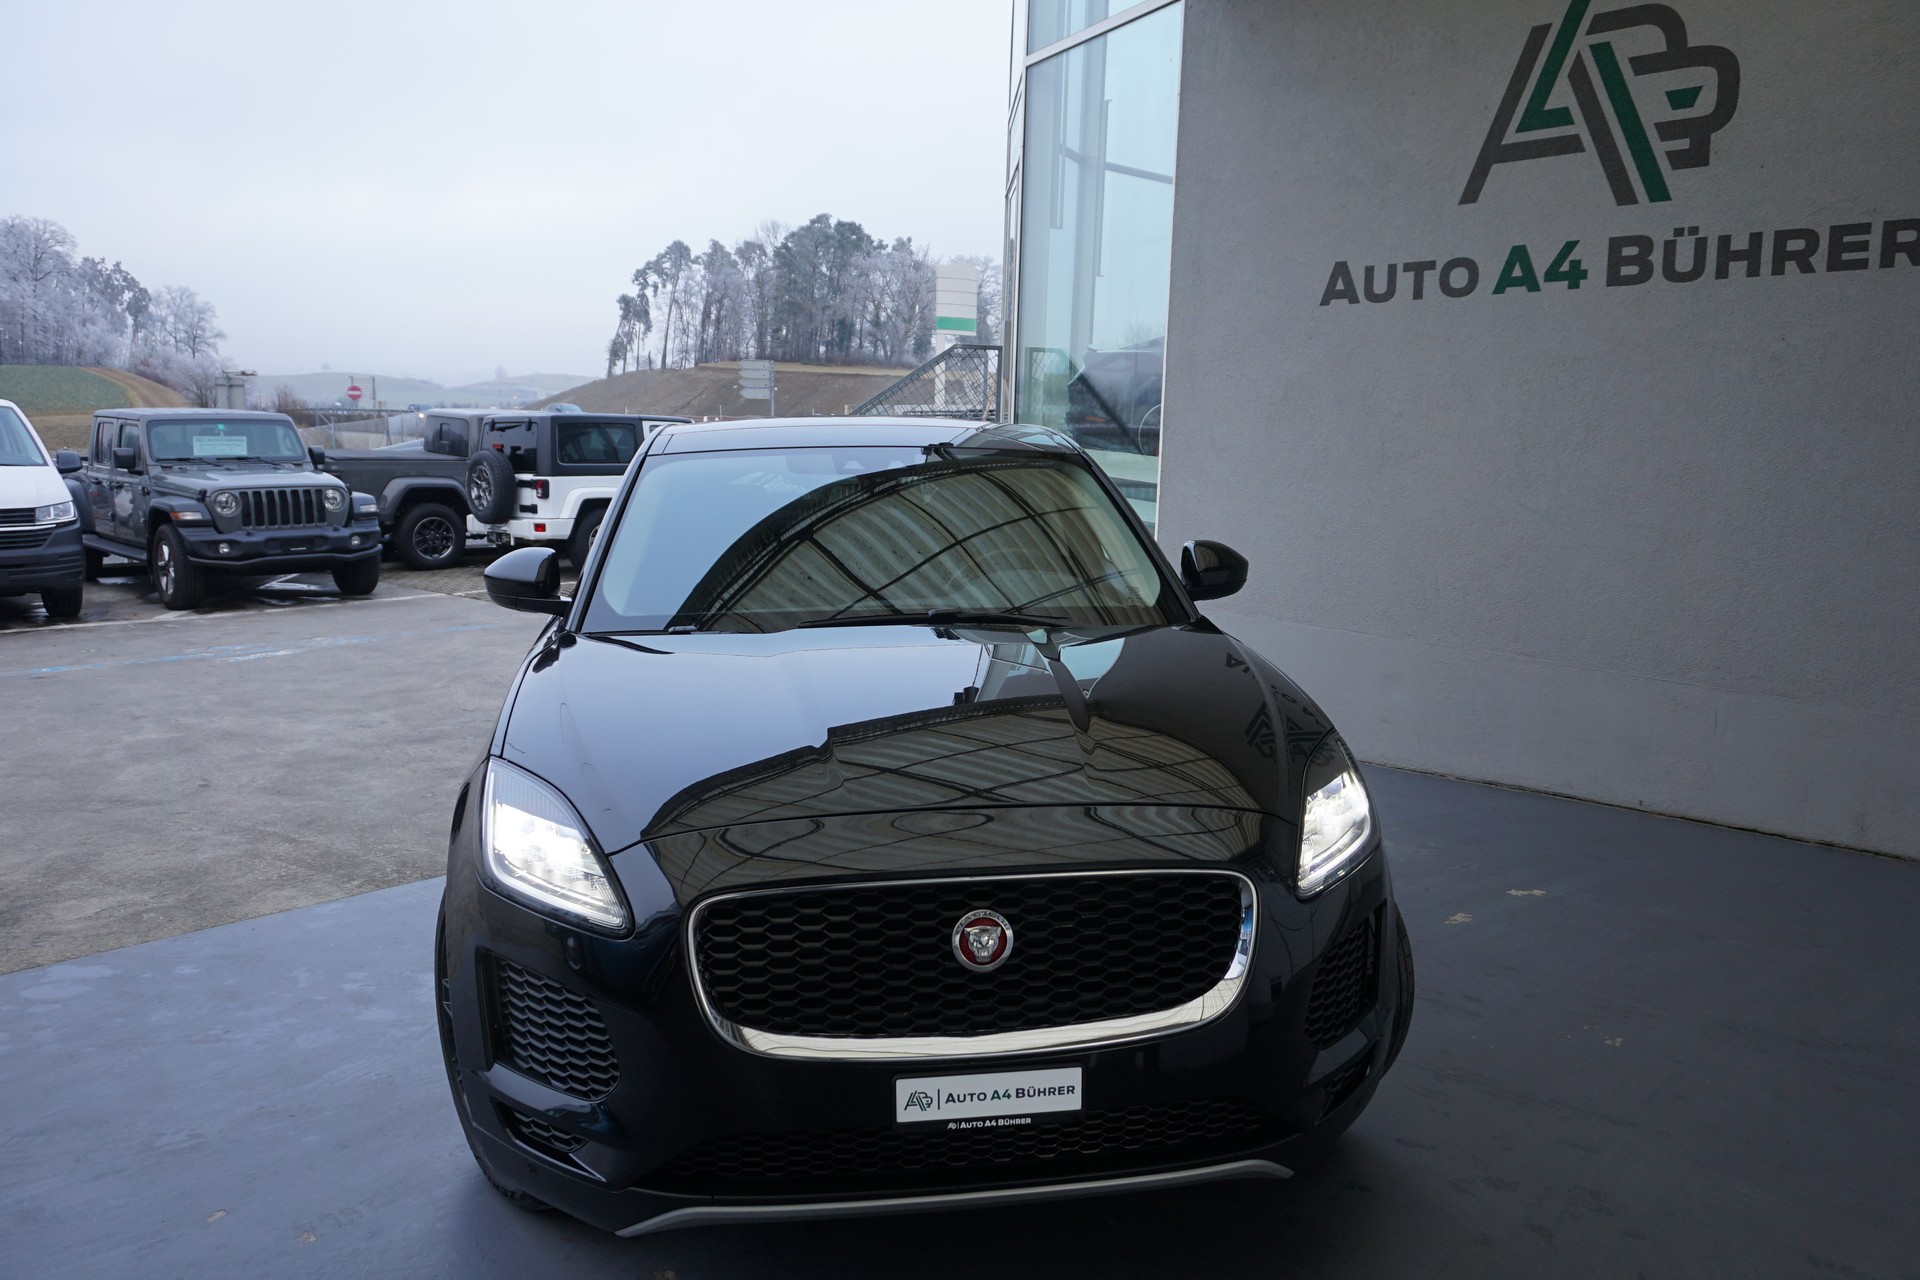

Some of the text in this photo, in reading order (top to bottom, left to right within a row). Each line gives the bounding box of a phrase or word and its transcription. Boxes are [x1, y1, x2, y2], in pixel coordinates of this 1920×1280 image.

[1320, 218, 1920, 306] AUTO A4 BÜHRER
[945, 1092, 987, 1104] AUTO
[990, 1089, 1012, 1101] A4
[1015, 1085, 1076, 1099] BÜHRER
[960, 1121, 983, 1129] AUTO
[984, 1119, 997, 1127] A4
